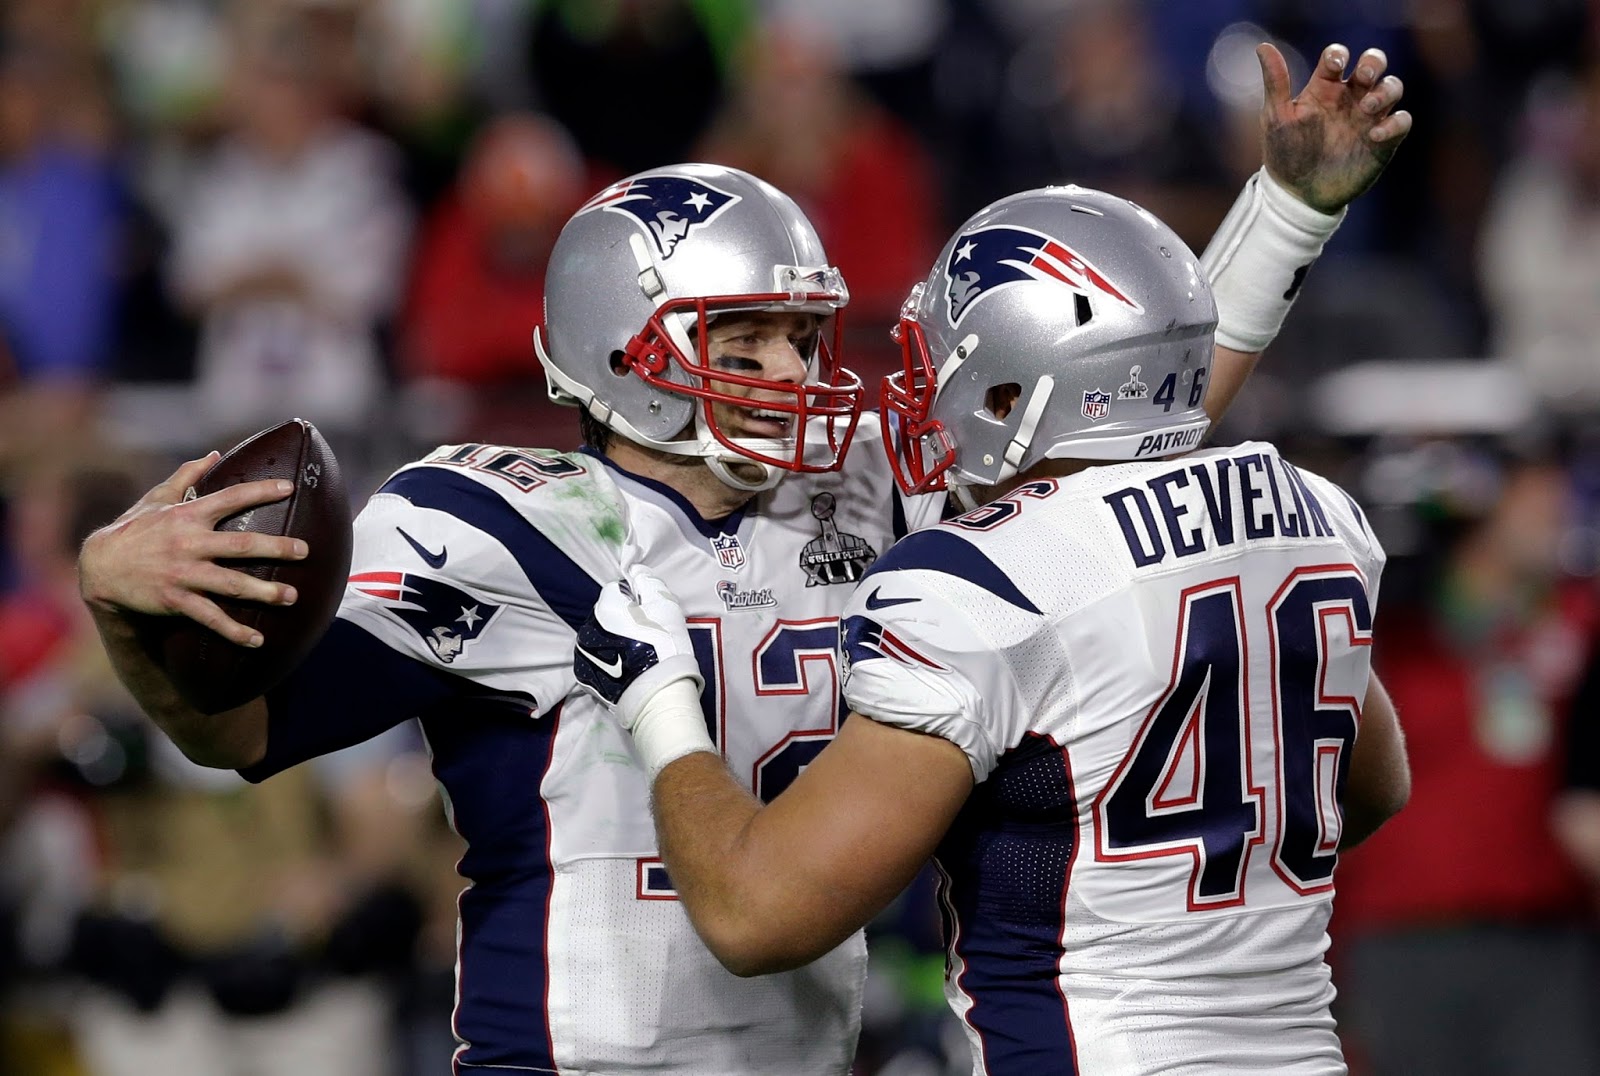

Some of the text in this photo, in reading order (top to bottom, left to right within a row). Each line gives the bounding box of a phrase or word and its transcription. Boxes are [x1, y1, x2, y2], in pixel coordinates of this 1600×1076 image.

[1152, 367, 1206, 413] 46
[1085, 402, 1107, 416] NFL
[424, 443, 587, 493] 12
[721, 549, 743, 567] NFL
[723, 588, 778, 611] Patriots
[1092, 563, 1373, 912] 46
